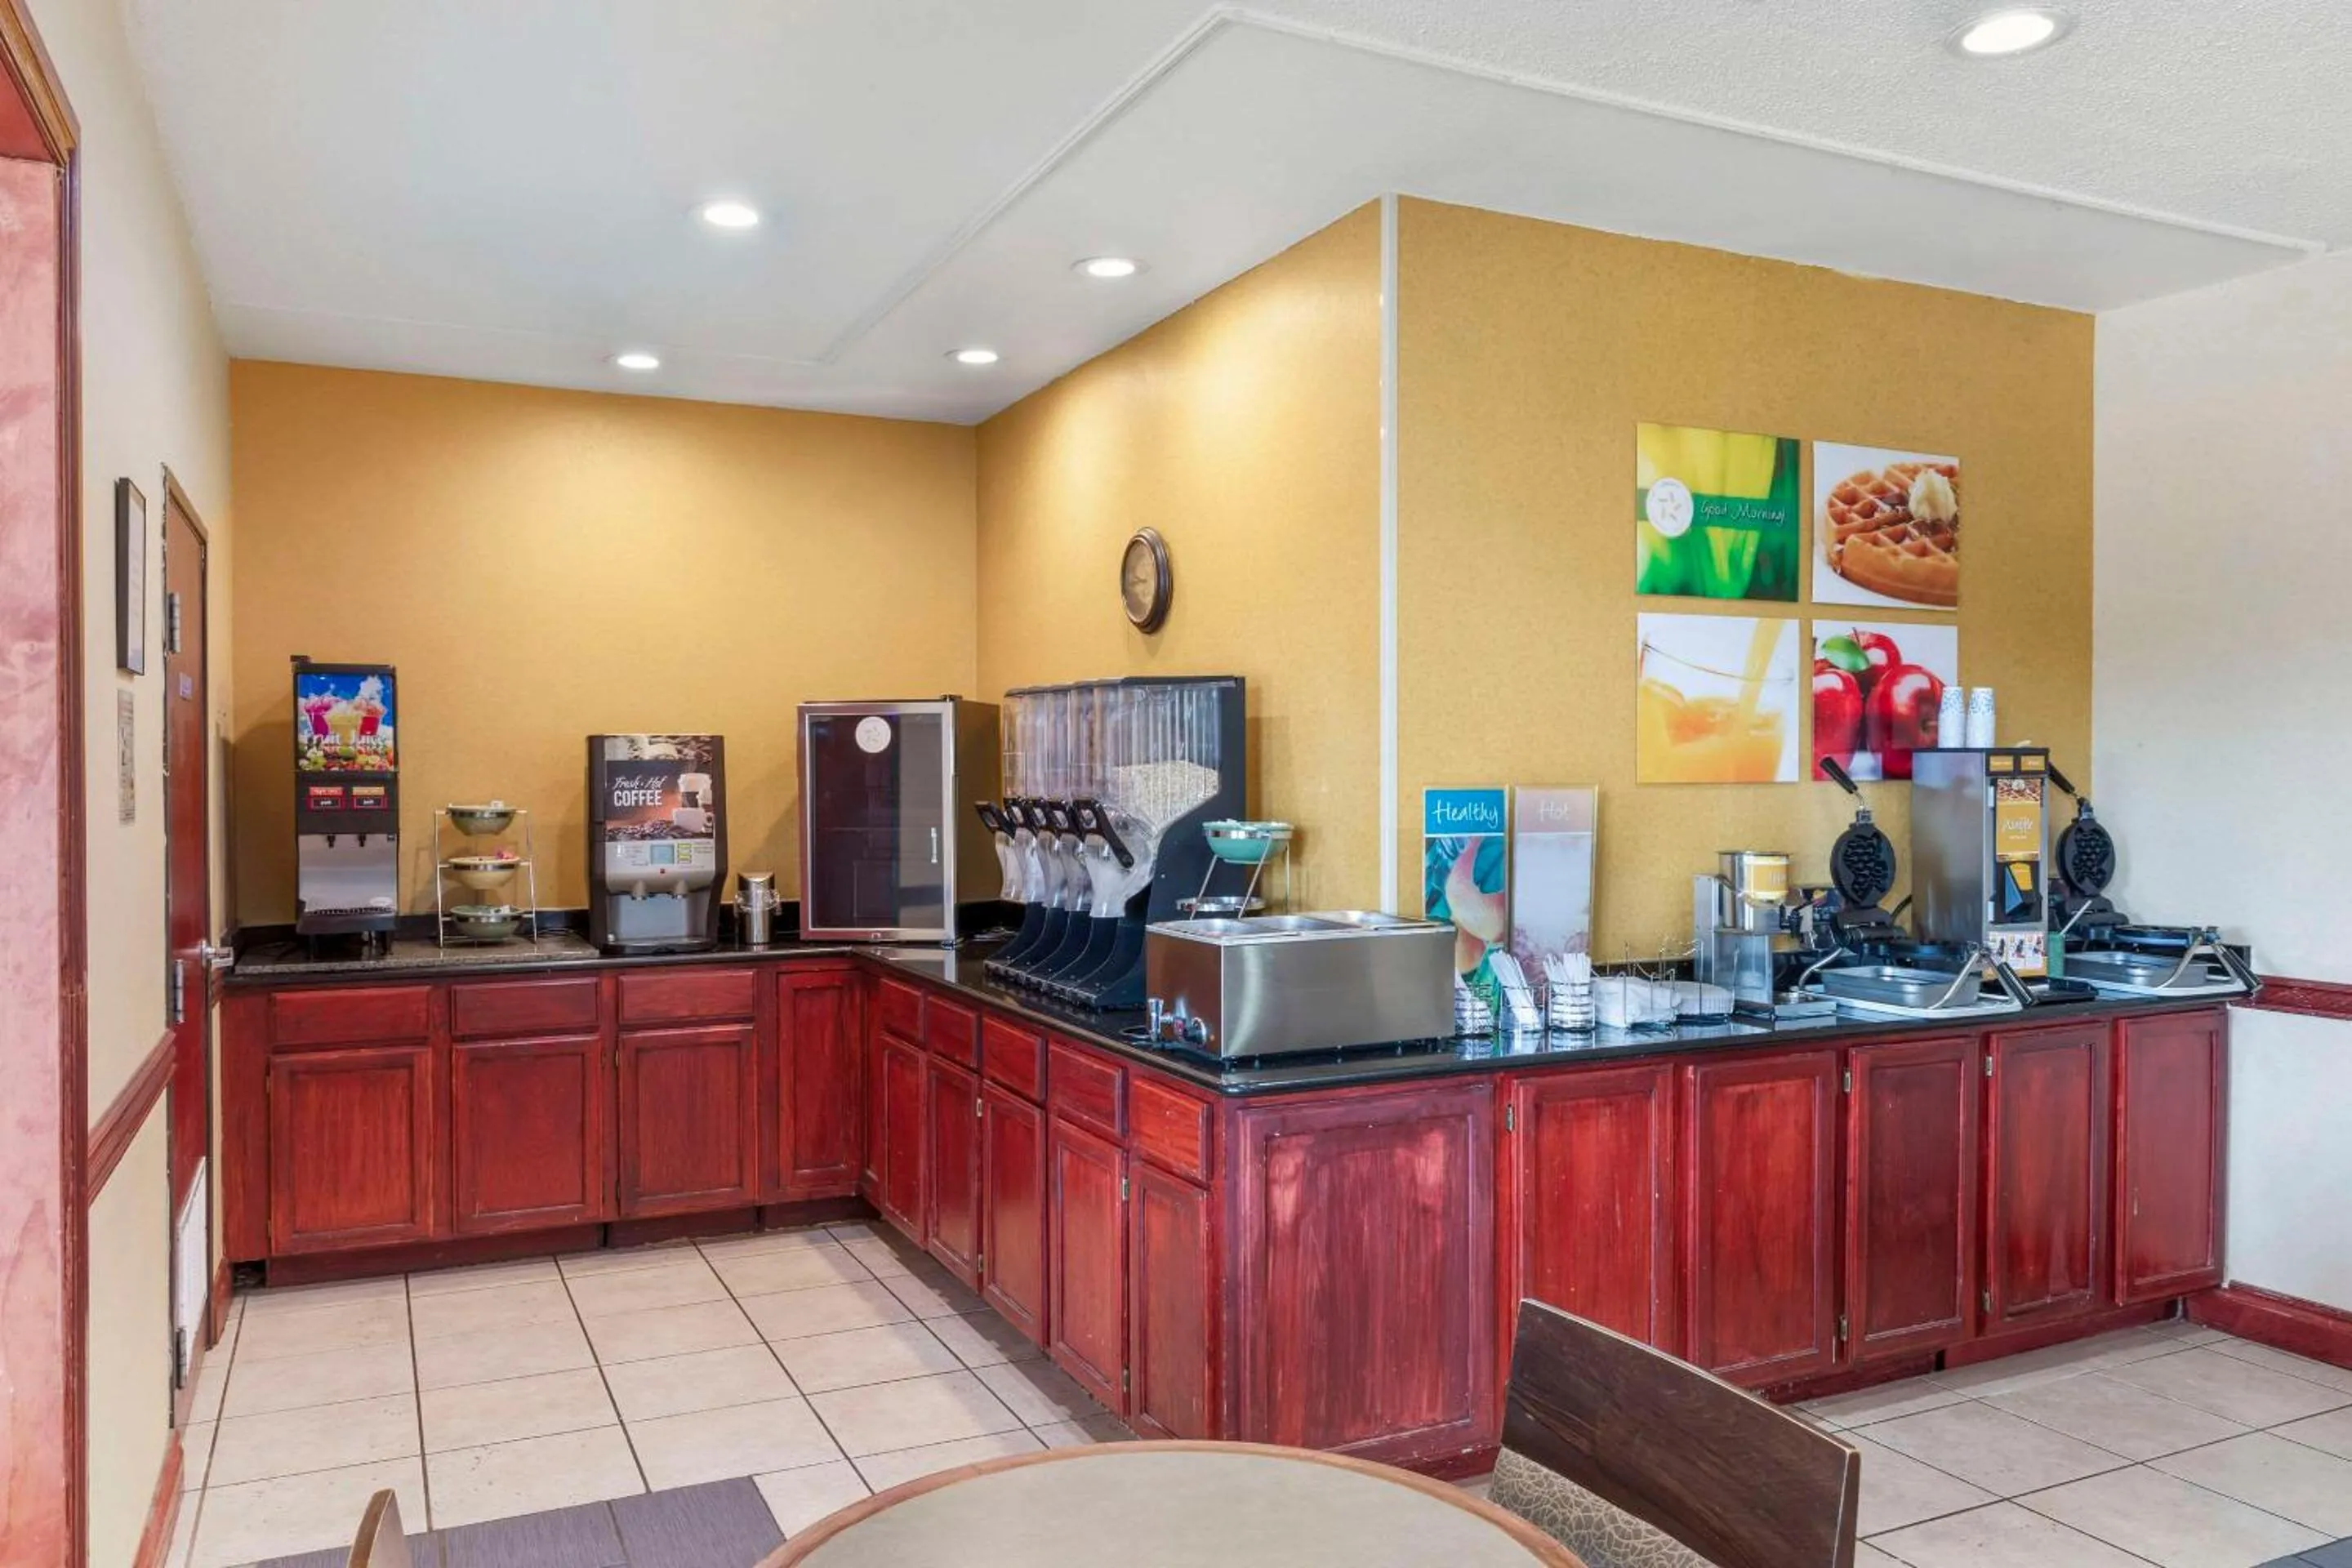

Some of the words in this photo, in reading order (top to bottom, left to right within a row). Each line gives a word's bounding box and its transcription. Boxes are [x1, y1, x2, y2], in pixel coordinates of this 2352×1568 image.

[1699, 500, 1727, 521] Good
[613, 789, 663, 807] COFFEE
[1432, 798, 1499, 830] Healthy
[1538, 798, 1570, 823] Hot
